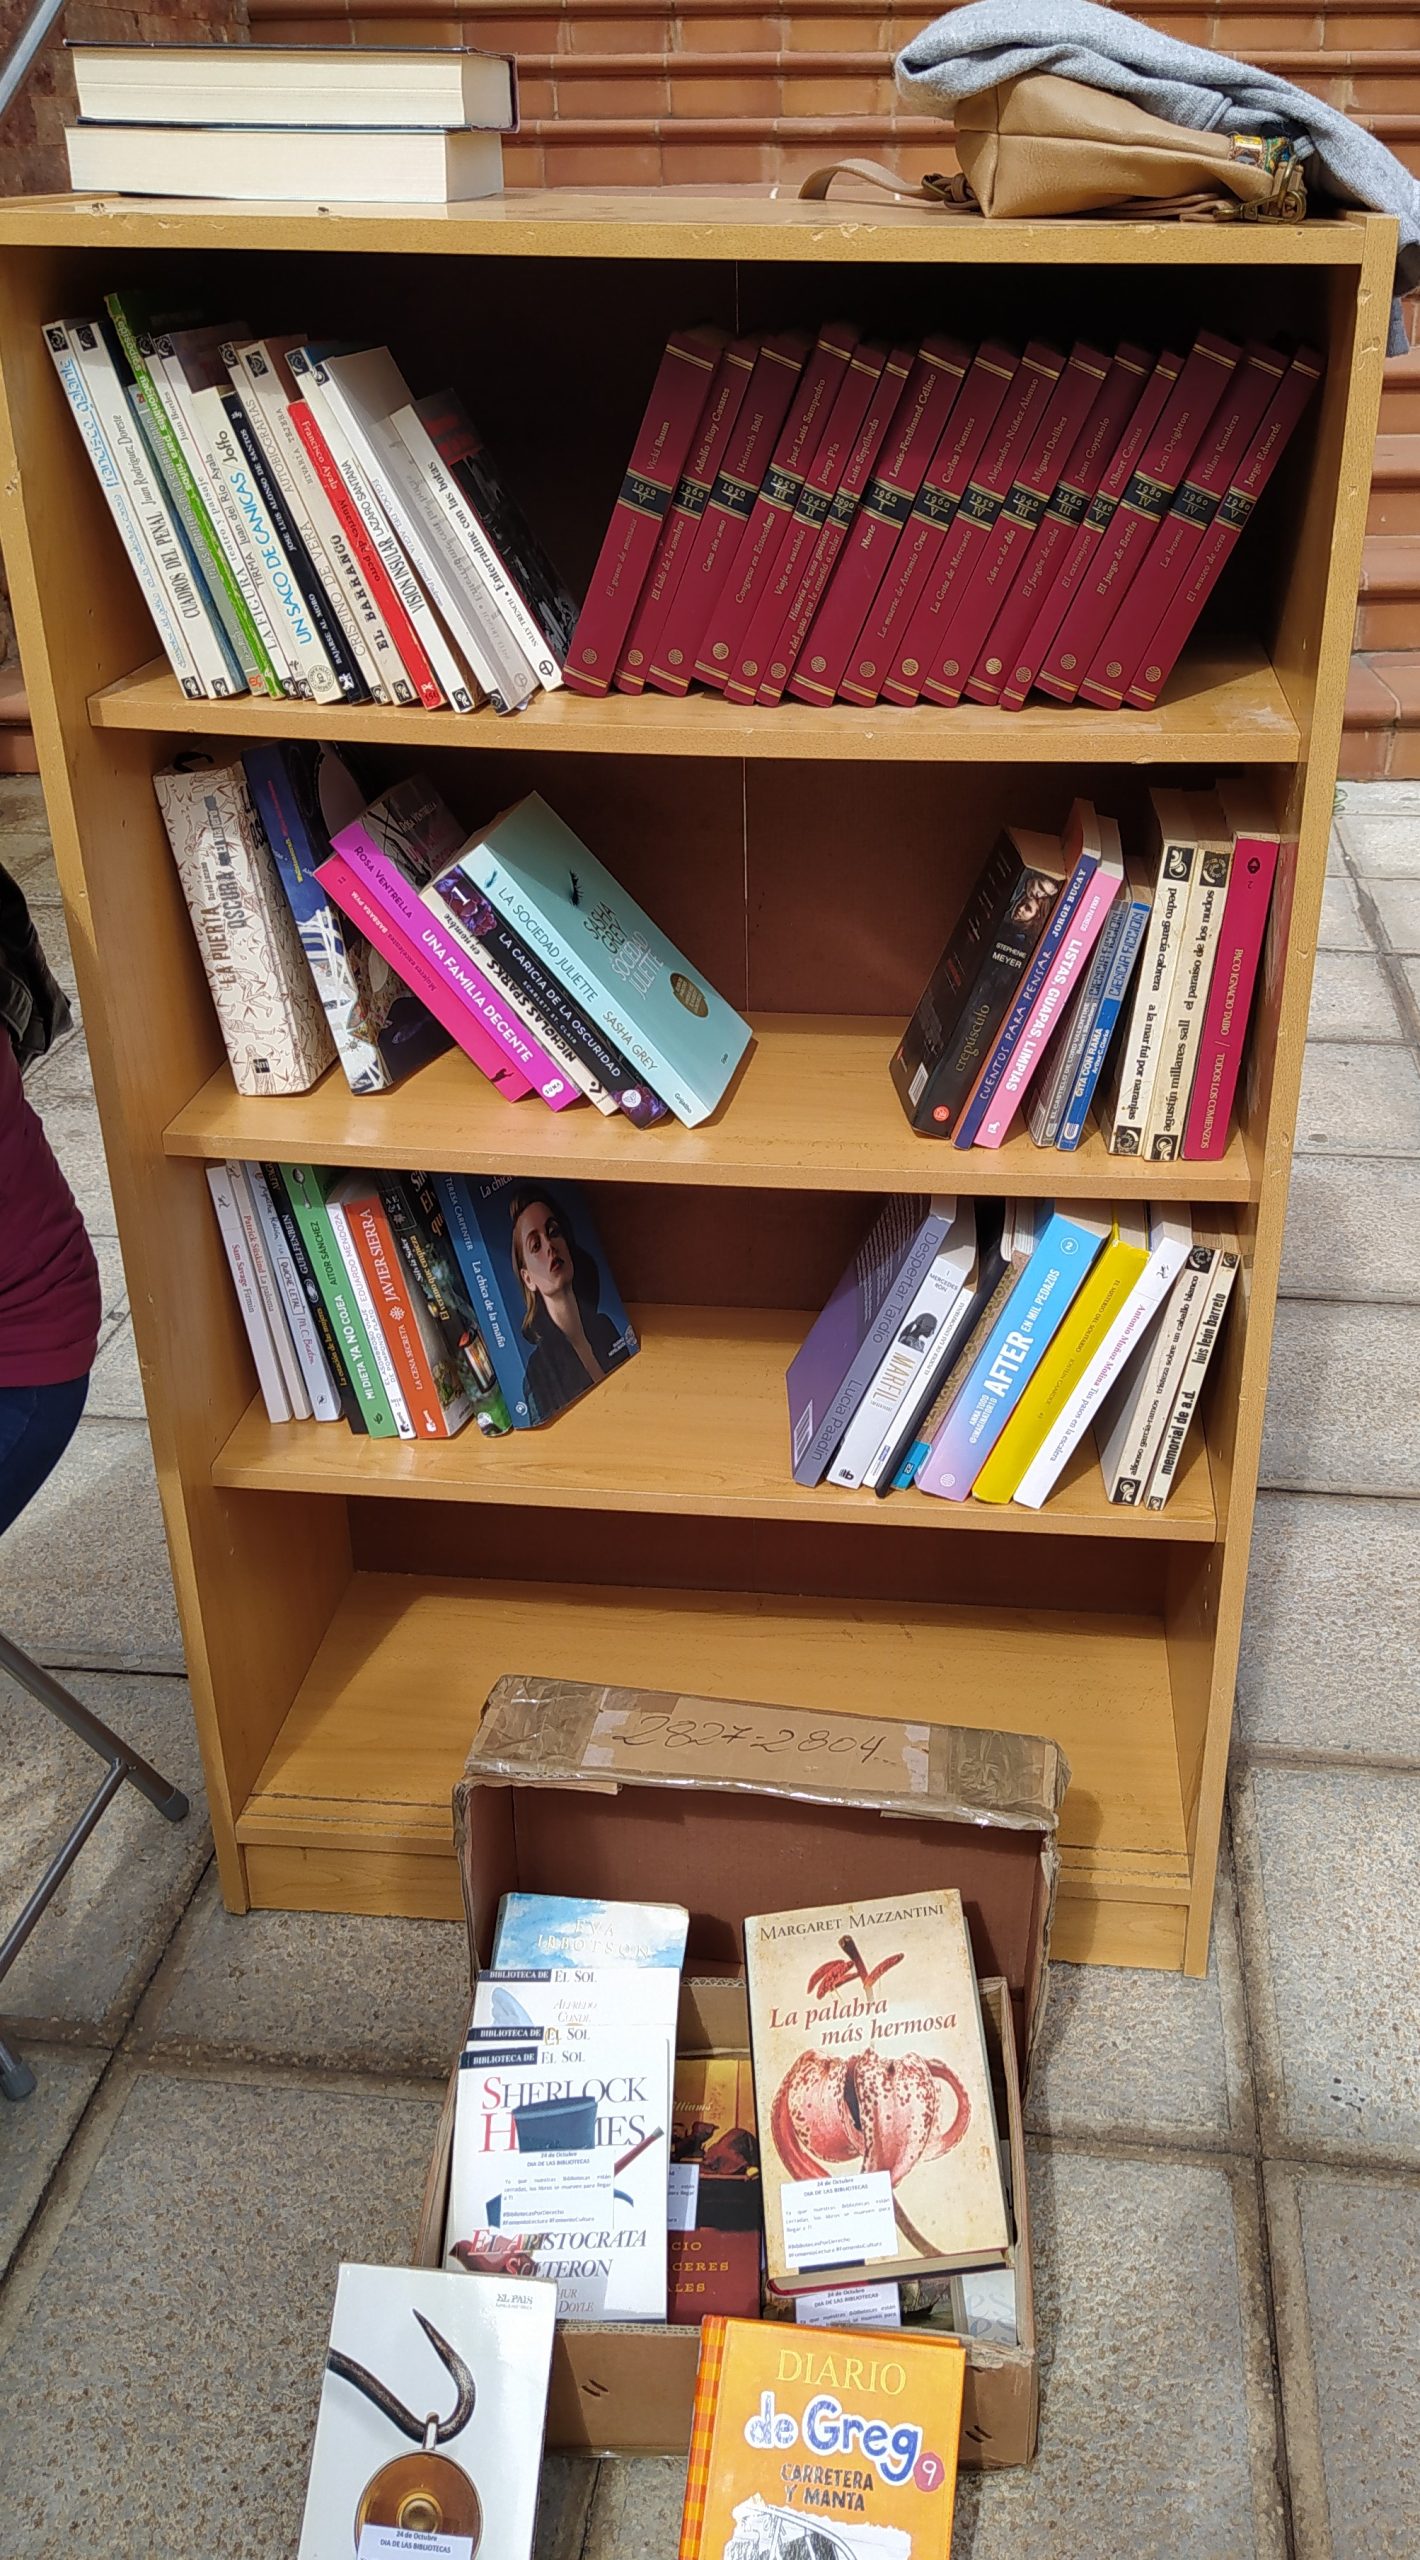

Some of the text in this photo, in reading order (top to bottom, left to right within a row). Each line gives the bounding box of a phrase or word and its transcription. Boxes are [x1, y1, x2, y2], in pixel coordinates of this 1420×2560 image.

[302, 420, 338, 490] Francisco Ayala
[694, 445, 710, 474] Adolfo
[712, 388, 730, 422] Casares
[787, 445, 800, 467] José
[802, 379, 826, 424] Sampedro
[888, 404, 924, 478] Louis-Ferdinand
[942, 417, 975, 483] Carlos Fuentes
[1031, 416, 1068, 483] Miguel Delibes
[1244, 423, 1281, 488] Jorge Edwards
[112, 415, 200, 619] CUADROS DEL PENAL Juan Rodríguez Doreste
[215, 430, 312, 644] UN SACO DE CANICAS Joffo
[299, 519, 323, 562] VERA
[341, 460, 425, 614] VISION INSULAR LAZARO SANTANA
[428, 462, 505, 592] Enterradme con las botas
[860, 524, 876, 549] Norte
[316, 565, 337, 589] DE
[330, 535, 389, 652] EL BARRANCO
[1096, 582, 1108, 595] El
[1102, 560, 1118, 585] juego
[1114, 548, 1124, 560] de
[328, 590, 369, 659] CRISTINO
[354, 846, 412, 918] ROSA VENTRELLA
[1052, 869, 1086, 938] JORGE BUCAY
[201, 906, 231, 960] PUERTA
[498, 887, 598, 1003] LA SOCIEDAD JULIETTE
[992, 952, 1022, 969] MEYER
[1152, 888, 1177, 991] pedro garcía cabrera
[1184, 890, 1214, 1010] el paraíso de los nudos
[422, 929, 533, 1062] UNA FAMILIA DECENTE
[486, 960, 576, 1062] NICHOLAS SPARKS
[499, 932, 621, 1076] LA CARICIA DE LA OSCURIDAD
[980, 951, 1052, 1100] CUENTOS PARA PENSAR
[1006, 939, 1082, 1091] LISTAS, GUAPAS, LIMPIAS
[602, 1011, 658, 1070] SASHA GREY
[956, 1004, 990, 1072] crepúsculo
[1074, 1028, 1104, 1097] CITA CON RAMA
[1163, 1020, 1190, 1132] agustín millares sall
[232, 1244, 255, 1313] Sam Savage Firmin
[310, 1221, 338, 1286] AITOR SÁNCHEZ
[334, 1213, 368, 1302] EDUARDO MENDOZA
[360, 1209, 401, 1302] JAVIER SIERRA
[895, 1232, 939, 1301] Despertar
[472, 1260, 506, 1348] La chica de la mafia
[872, 1304, 904, 1343] Tardío
[1020, 1269, 1060, 1332] EN MIL PEDAZOS
[1191, 1293, 1226, 1364] luis león barreto
[334, 1294, 375, 1400] MI DIETA YA NO COJEA
[872, 1352, 916, 1402] MARFIL
[984, 1332, 1034, 1398] AFTER
[1094, 1304, 1146, 1386] Antonio Muñoz Molina
[835, 1380, 863, 1415] Lucía
[1161, 1391, 1196, 1475] memorial de a.d.
[760, 1904, 944, 1942] MARGARET MAZZANTINI
[489, 1970, 598, 1983] BIBLIOTECA DE EL SOL
[768, 1997, 888, 2031] La palabra
[821, 2012, 958, 2046] más hermosa
[473, 2050, 586, 2065] BIBLIOTECA DE EL SOL
[482, 2076, 649, 2110] SHERLOCK
[467, 2229, 648, 2256] EL ARISTOCRATA
[775, 2348, 907, 2395] DIARIO
[746, 2391, 921, 2484] de Greg
[780, 2462, 875, 2492] CARRETERA
[784, 2484, 866, 2512] Y MANTA
[921, 2459, 938, 2487] 9
